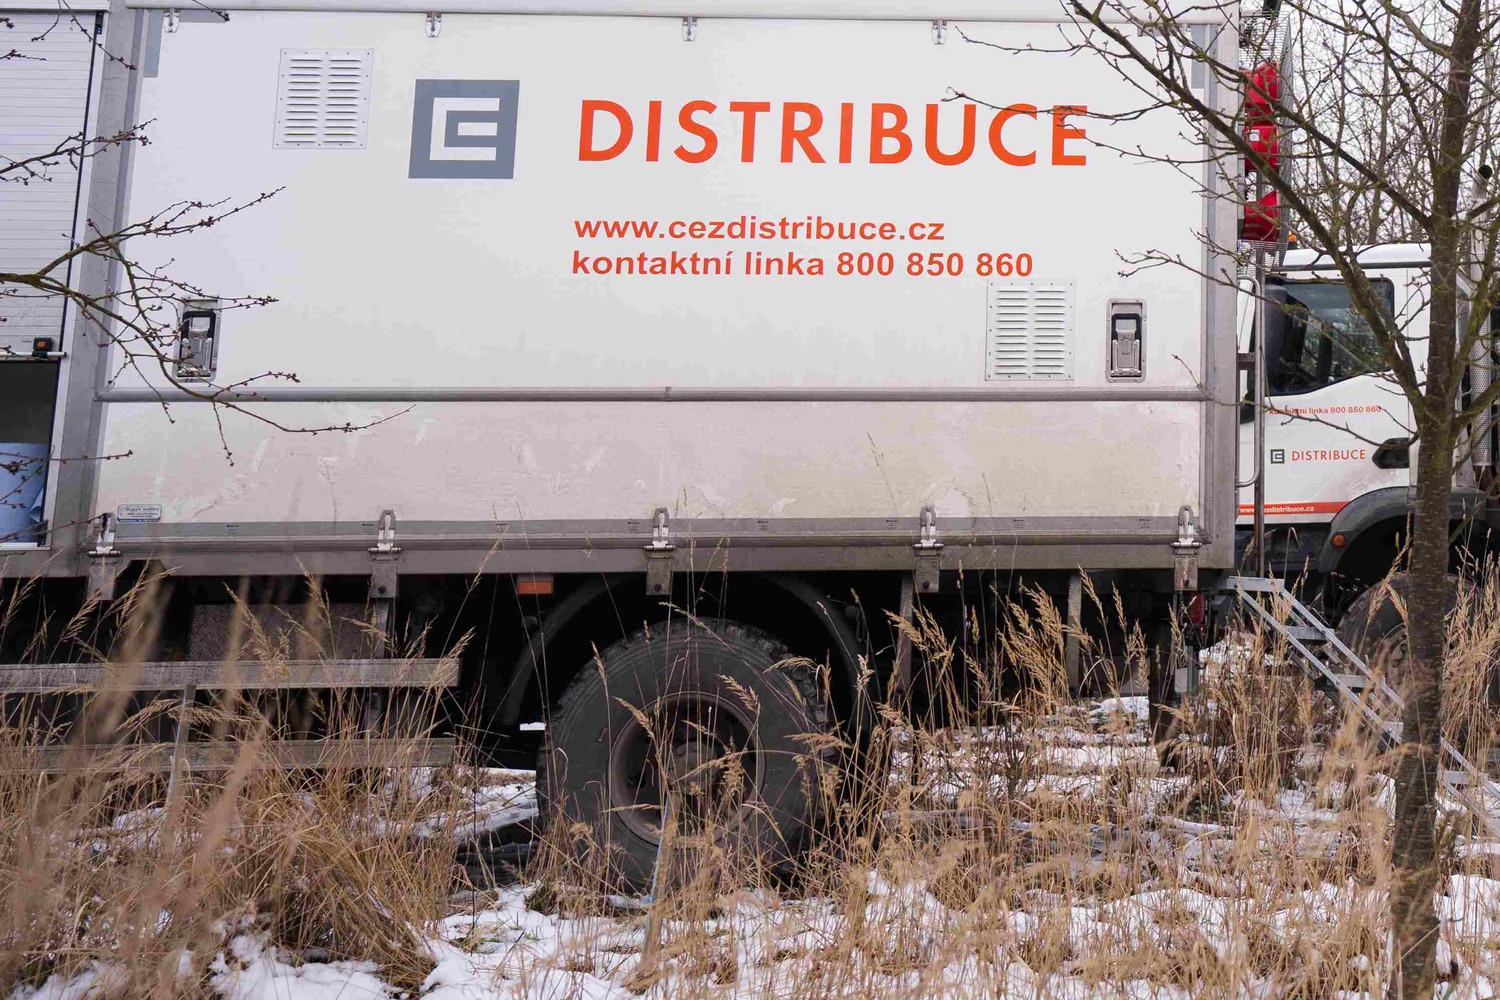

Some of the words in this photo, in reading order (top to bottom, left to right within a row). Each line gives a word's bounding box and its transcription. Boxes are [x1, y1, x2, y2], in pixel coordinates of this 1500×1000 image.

[578, 99, 1088, 167] DISTRIBUCE
[574, 215, 945, 240] www.cezdistribuce.cz
[572, 250, 734, 275] kontaktní
[745, 251, 824, 275] linka
[836, 252, 894, 276] 800
[906, 252, 964, 276] 850
[976, 253, 1033, 277] 860
[1330, 406, 1346, 414] 800
[1348, 406, 1364, 414] 850
[1291, 449, 1366, 461] DISTRIBUCE
